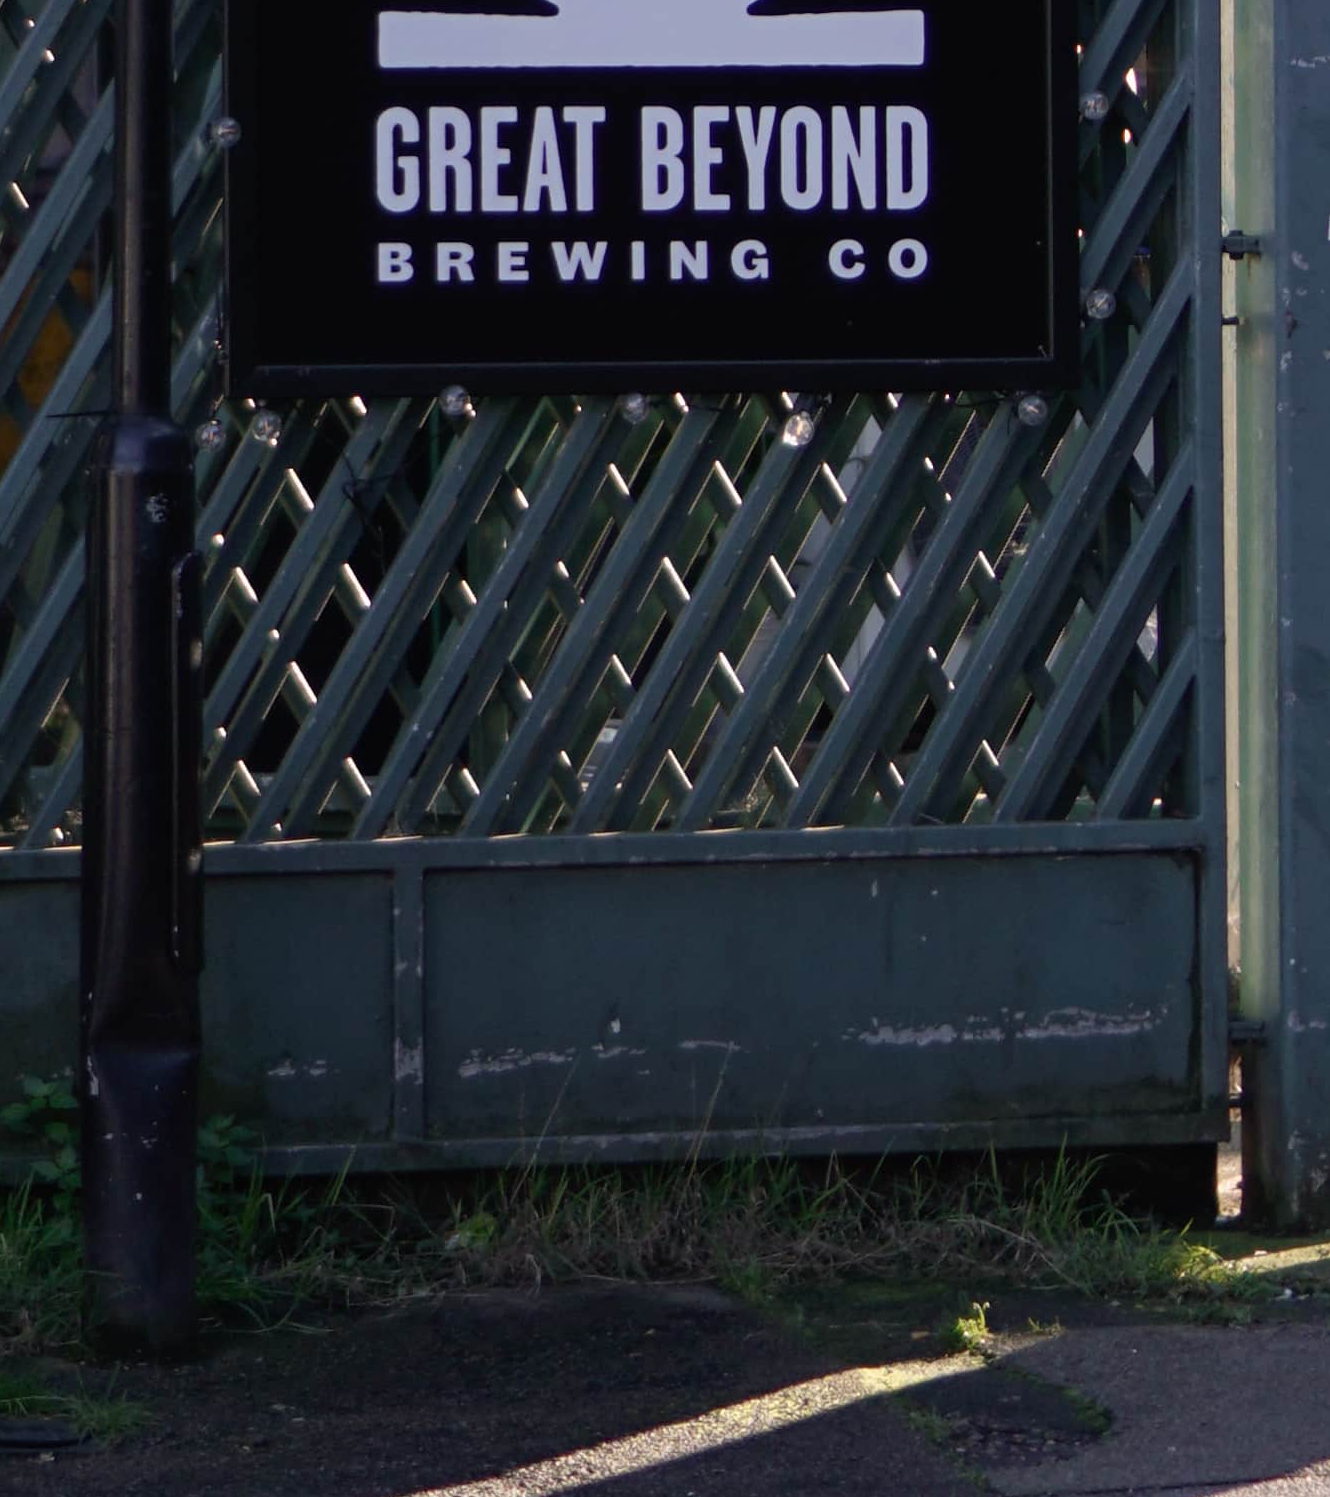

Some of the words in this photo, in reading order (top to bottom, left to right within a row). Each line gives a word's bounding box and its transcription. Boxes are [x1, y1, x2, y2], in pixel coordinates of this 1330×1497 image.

[375, 106, 606, 213] GREAT
[640, 105, 930, 212] BEYOND
[377, 240, 771, 283] BREWING
[828, 238, 930, 280] CO
